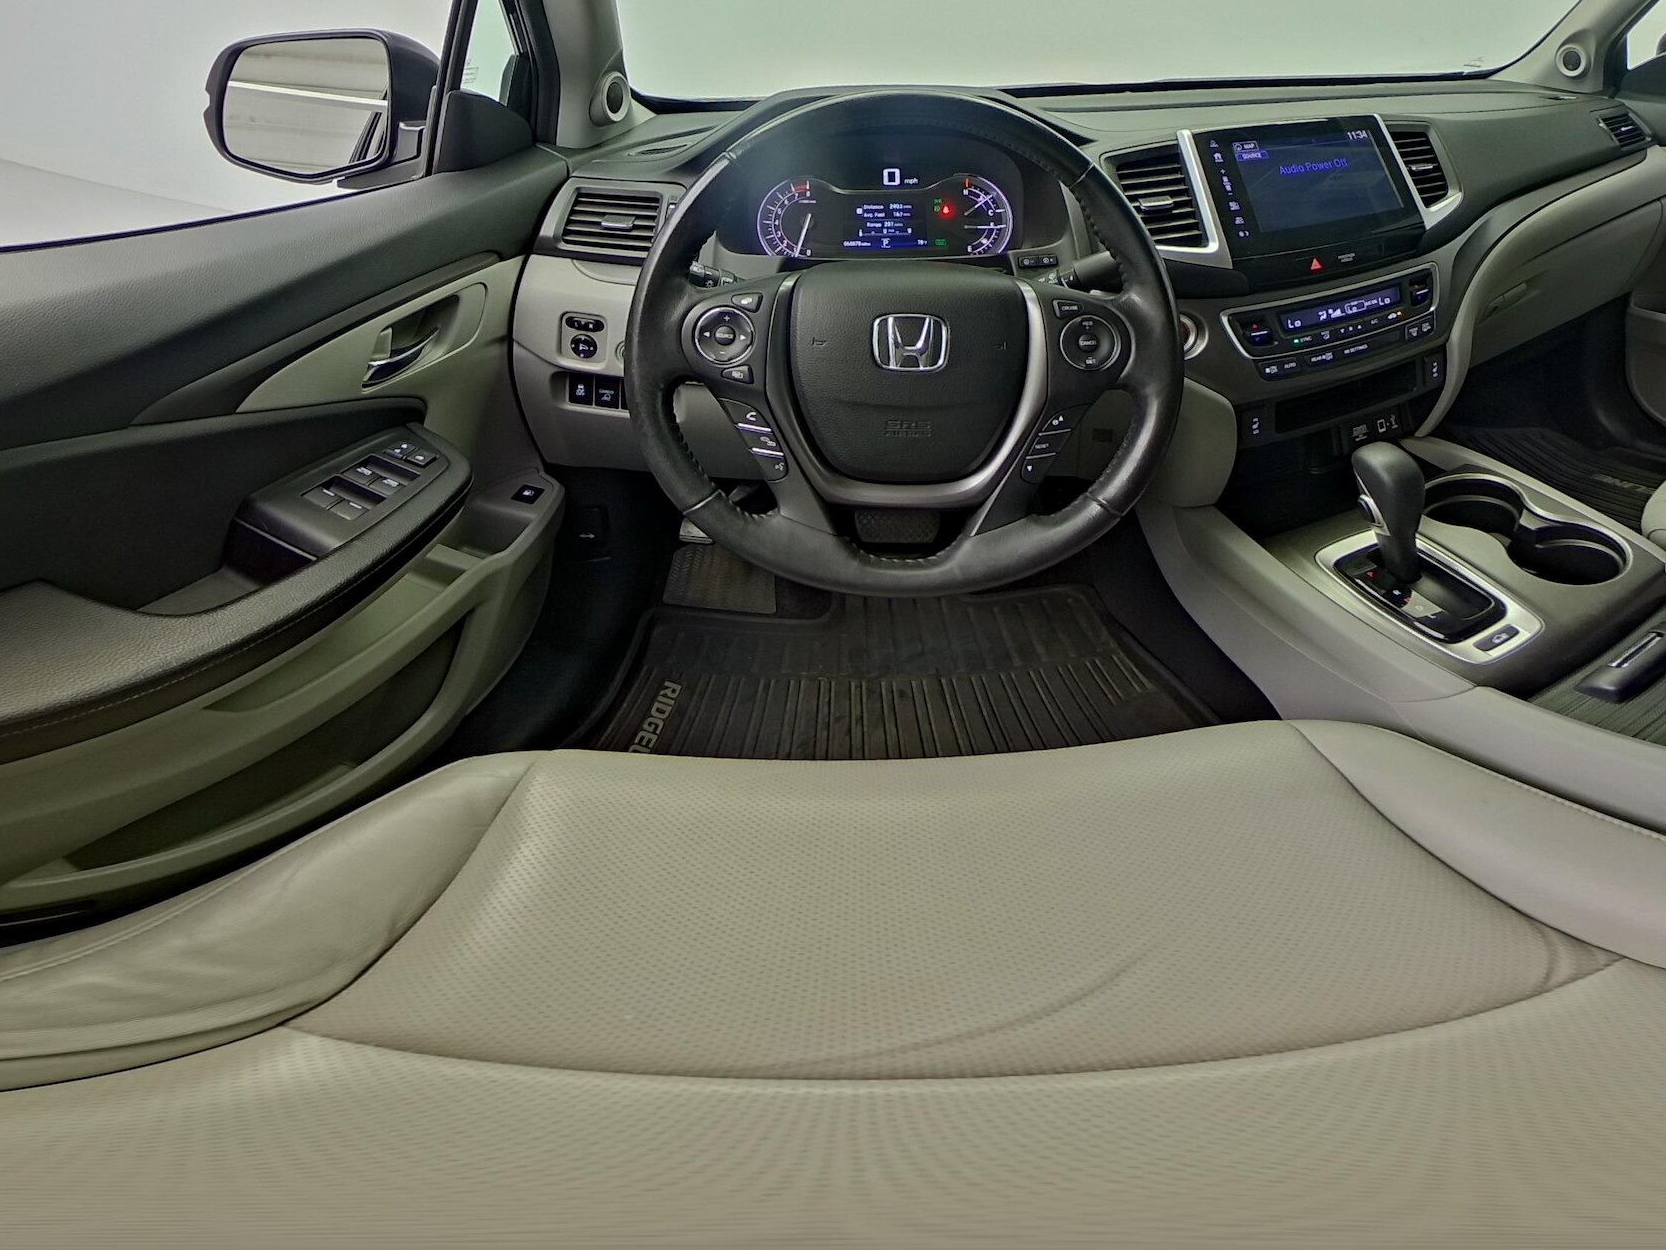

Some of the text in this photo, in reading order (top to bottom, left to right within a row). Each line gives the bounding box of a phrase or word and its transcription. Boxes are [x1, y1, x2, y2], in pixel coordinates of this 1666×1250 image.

[1279, 157, 1348, 175] Audio Power Off
[883, 168, 919, 186] 0 mph
[1378, 296, 1391, 306] Lo
[1287, 319, 1302, 328] Lo
